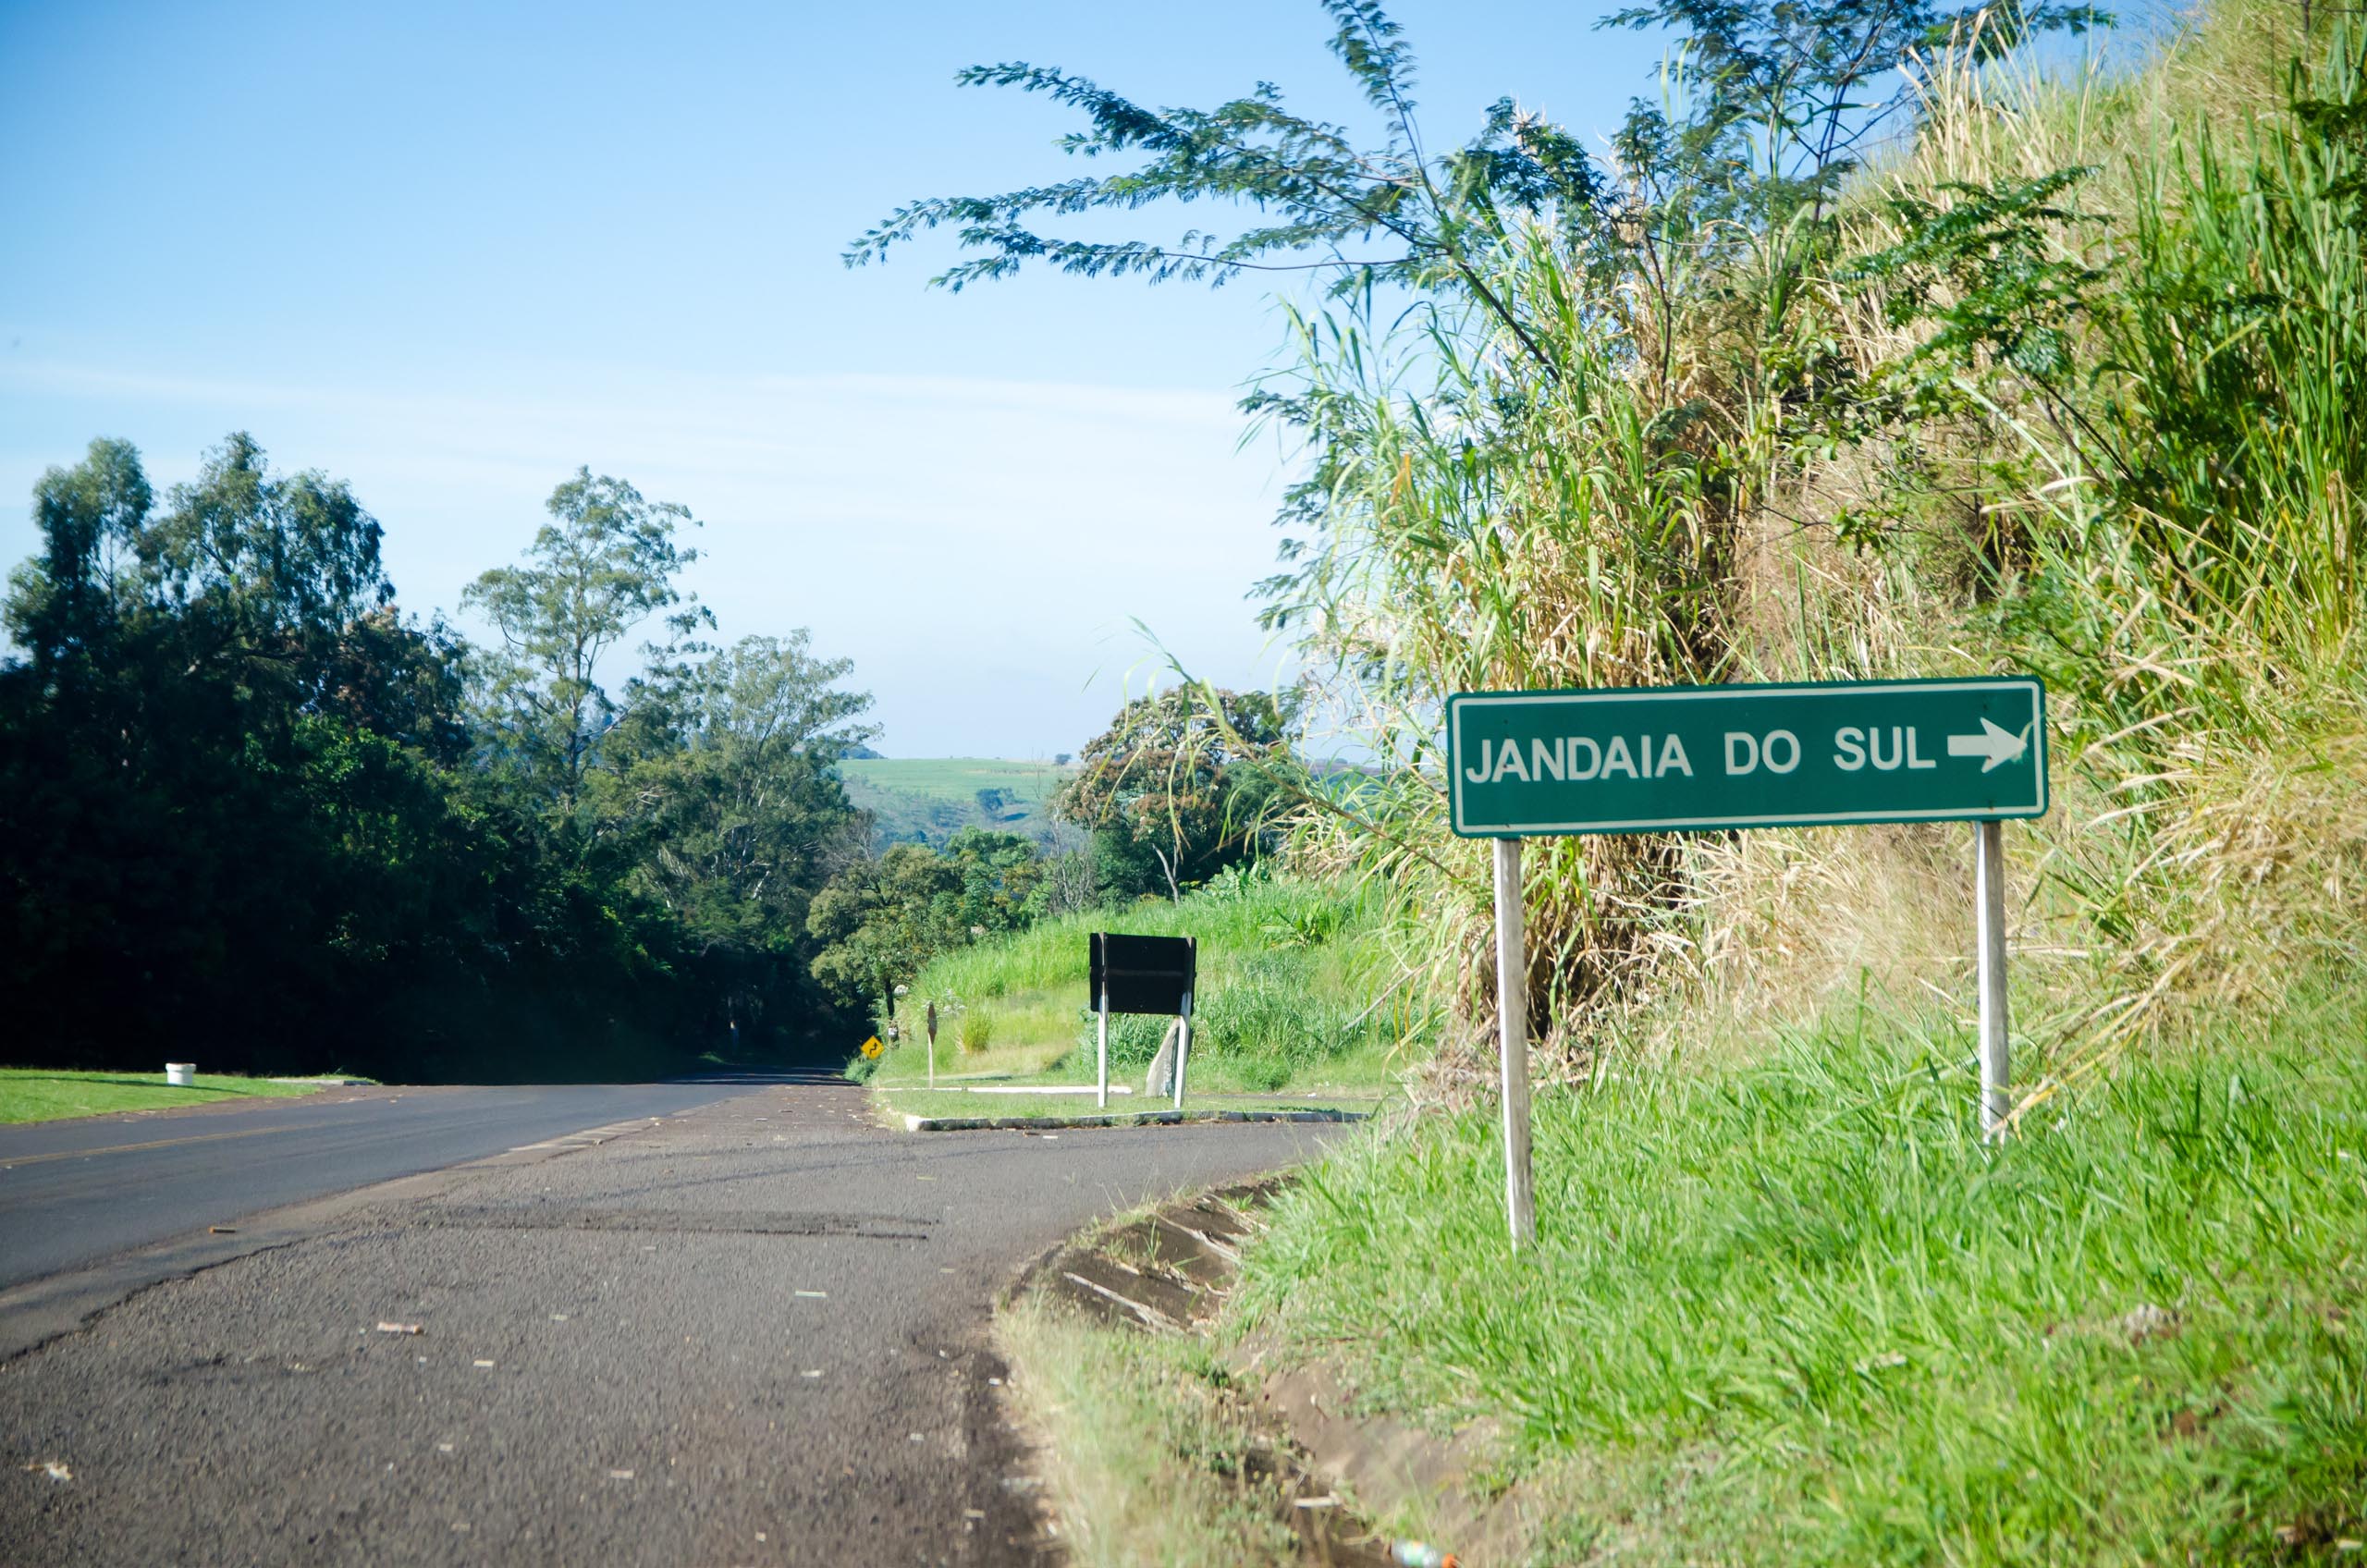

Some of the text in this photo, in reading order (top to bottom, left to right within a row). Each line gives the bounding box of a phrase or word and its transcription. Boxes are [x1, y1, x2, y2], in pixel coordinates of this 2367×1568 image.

[1466, 727, 1936, 783] JANDAIA DO SUL
